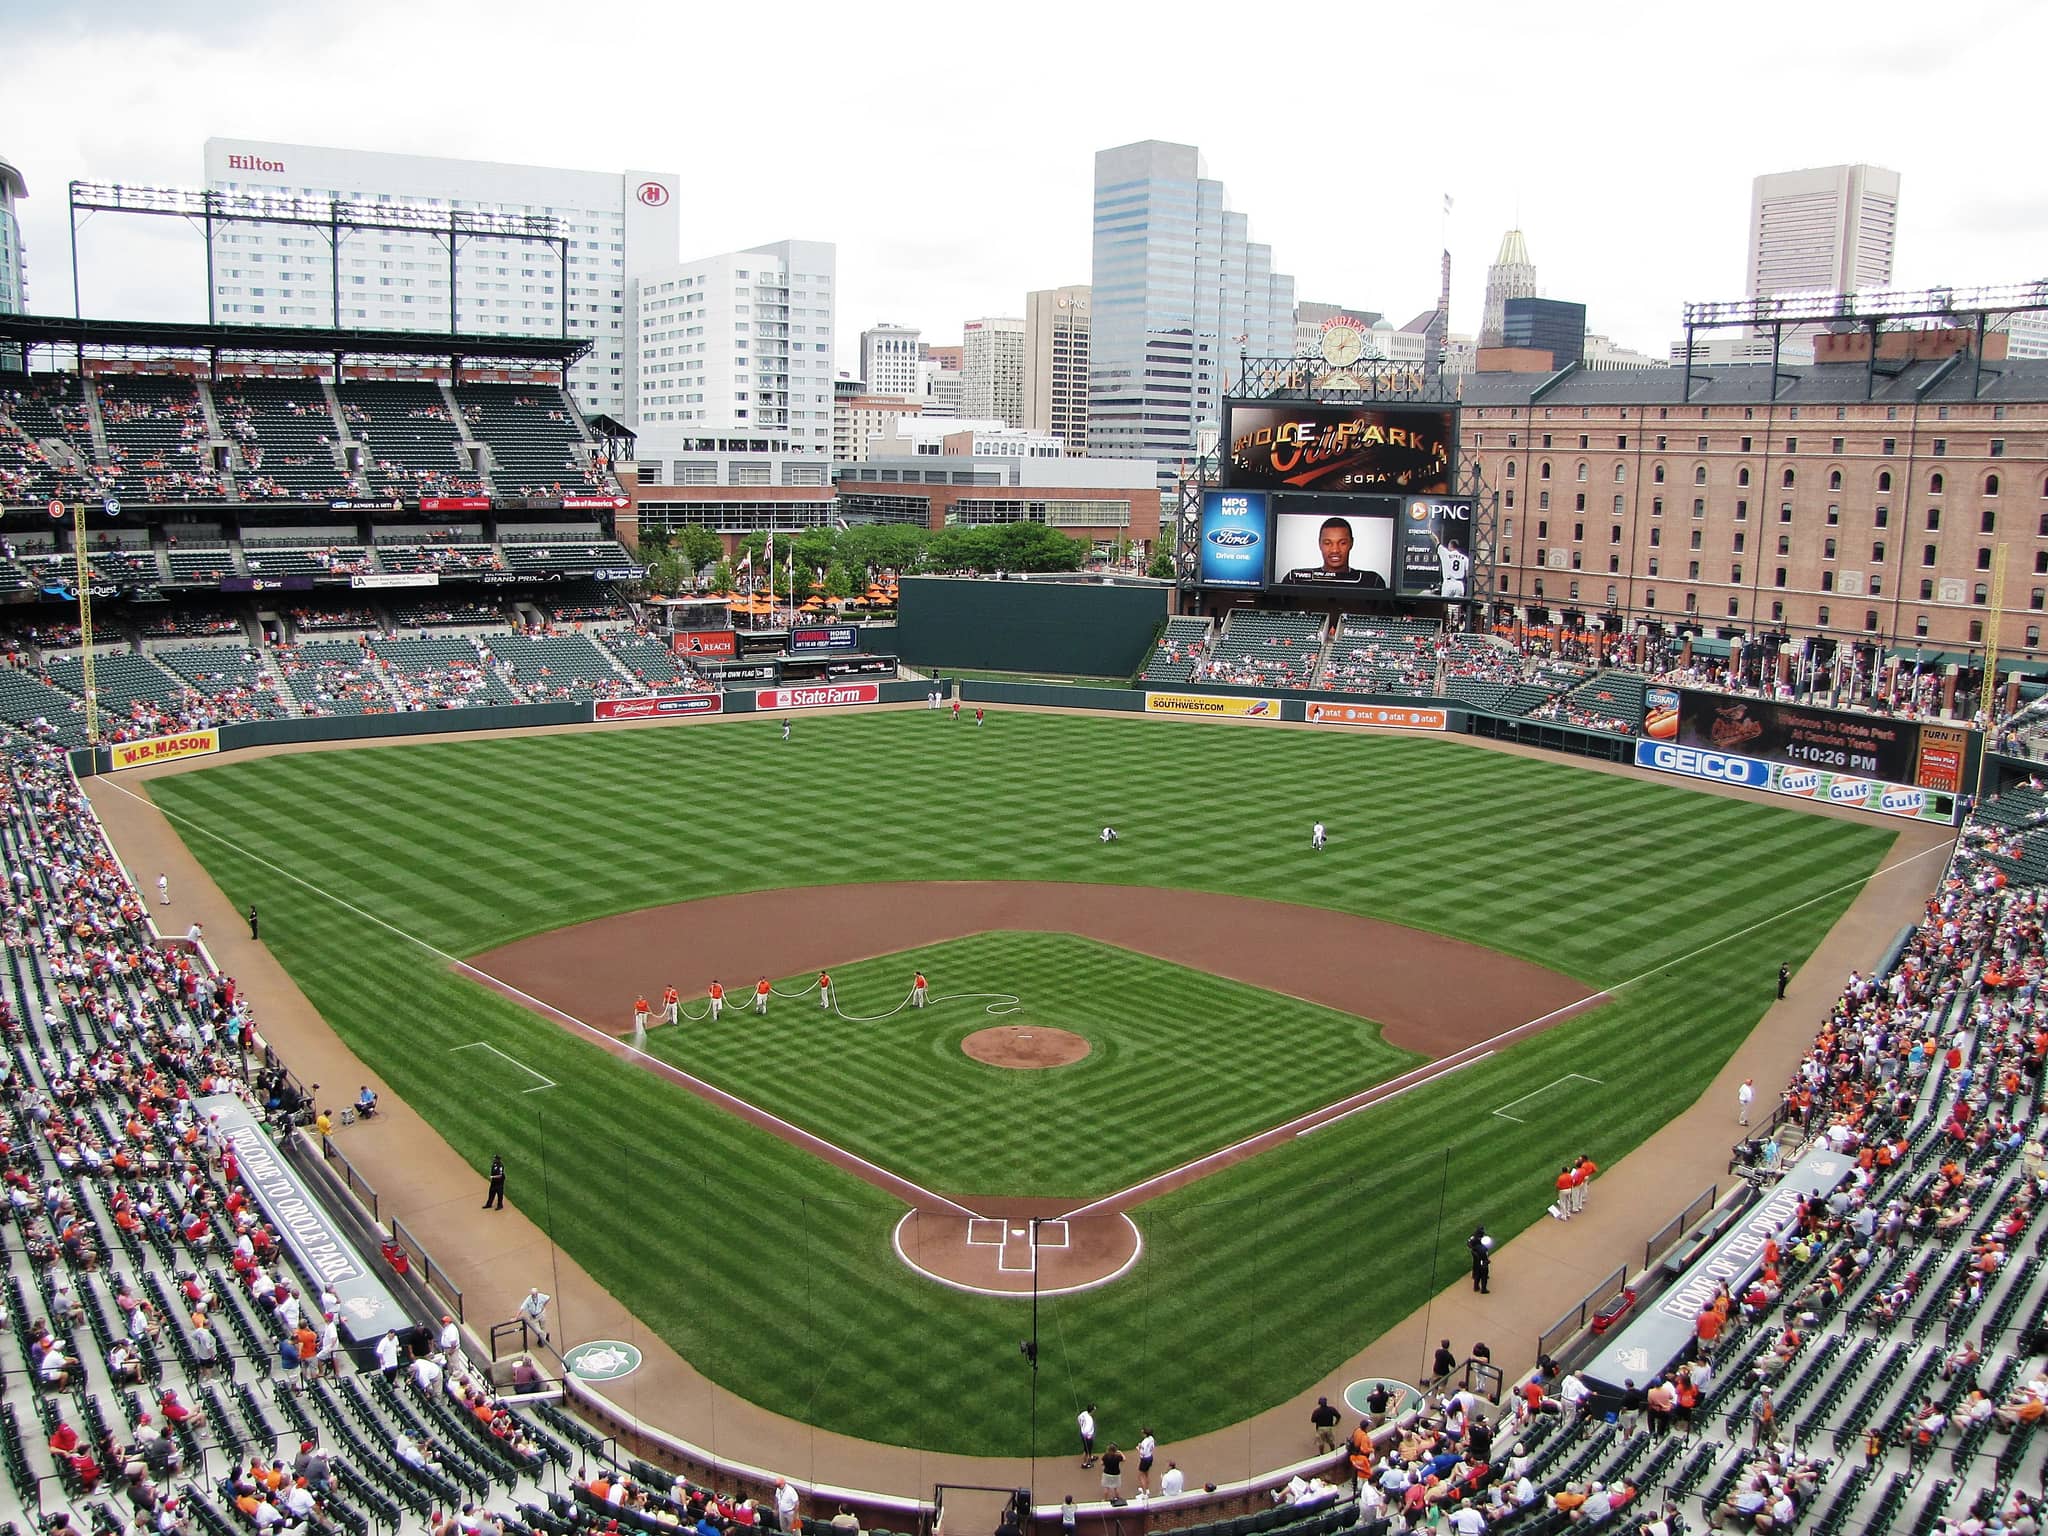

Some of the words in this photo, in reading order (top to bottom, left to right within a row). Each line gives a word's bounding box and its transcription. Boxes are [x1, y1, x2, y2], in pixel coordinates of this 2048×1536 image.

[228, 154, 285, 173] Hilton
[1321, 315, 1366, 333] ORIOLES
[1263, 369, 1306, 390] THE
[1377, 372, 1425, 392] SUN
[1338, 423, 1424, 451] PARK
[109, 504, 119, 514] 42
[564, 499, 579, 507] Bank
[1221, 497, 1248, 507] MPG
[1221, 507, 1248, 516] MVP
[1430, 504, 1470, 520] PNC
[1216, 530, 1249, 545] Ford
[1452, 560, 1459, 571] 8
[704, 643, 731, 651] REACH
[793, 690, 826, 705] State
[828, 688, 859, 703] Farm
[1649, 694, 1675, 705] ESSKAY
[1153, 700, 1224, 711] SOUTHWEST.COM
[1824, 720, 1837, 731] To
[1871, 727, 1896, 742] Park
[1923, 729, 1949, 740] TURN
[123, 745, 154, 764] W.B.
[155, 737, 210, 755] MASON
[1786, 743, 1845, 766] 1:10:26
[1851, 754, 1877, 771] PM
[1655, 745, 1750, 782] GEICO
[1782, 774, 1817, 790] Gulf
[1830, 783, 1868, 800] Gulf
[1882, 793, 1922, 809] Gulf
[228, 1126, 280, 1181] WELCOME
[262, 1177, 296, 1200] TO
[276, 1198, 332, 1246] ORIOLE
[1723, 1229, 1764, 1260] THE
[307, 1239, 357, 1283] PARK
[1705, 1253, 1743, 1278] OF
[1665, 1274, 1719, 1319] HOME
